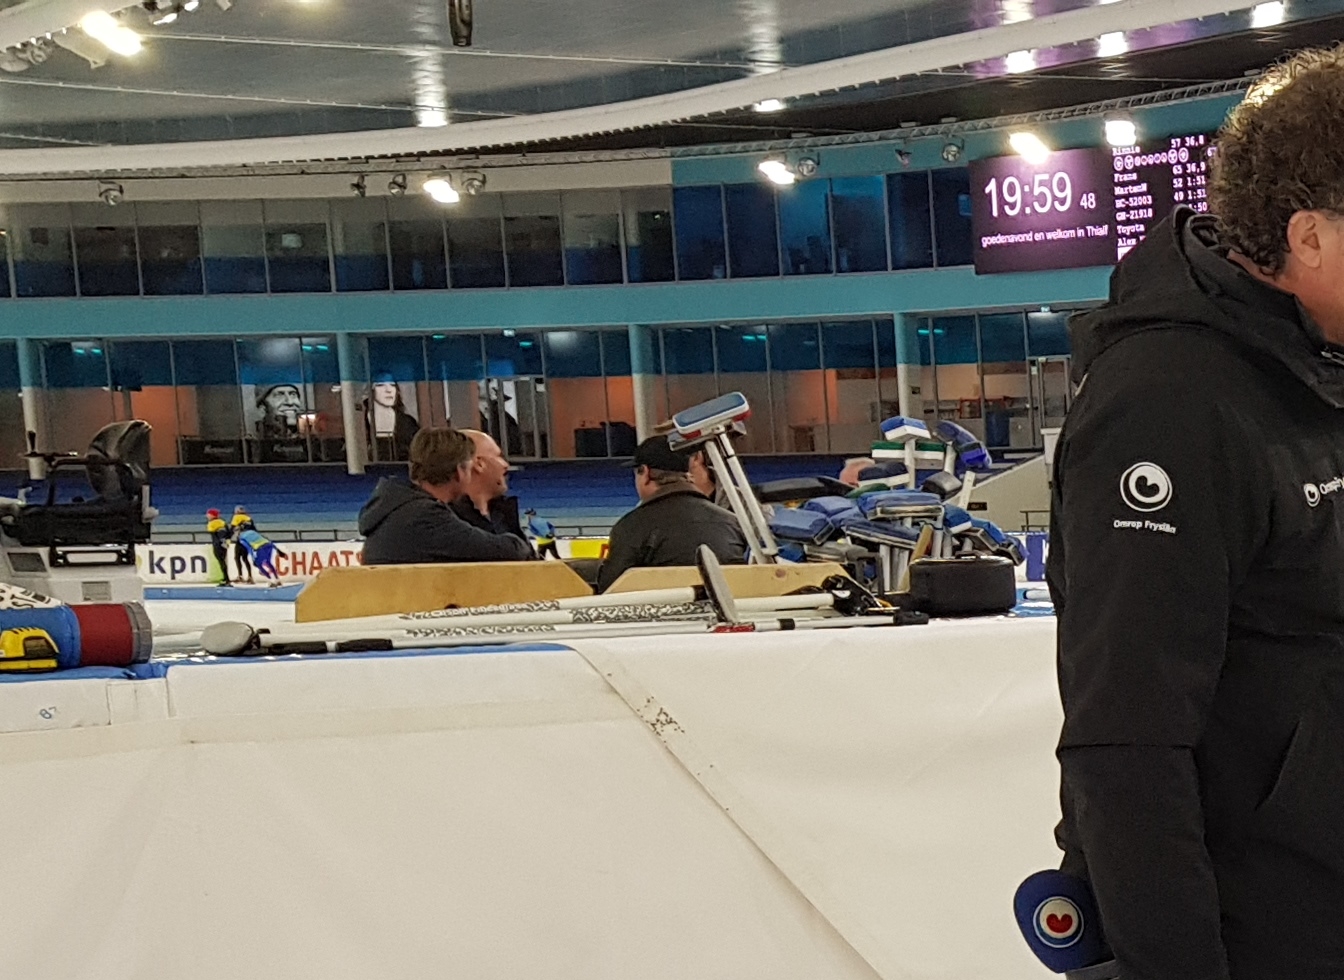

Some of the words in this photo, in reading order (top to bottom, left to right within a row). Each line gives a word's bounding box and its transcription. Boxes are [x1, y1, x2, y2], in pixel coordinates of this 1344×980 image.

[985, 171, 1072, 217] 19:59
[1080, 192, 1096, 209] 48
[981, 231, 1033, 248] goedenavond
[1046, 229, 1075, 240] welkom
[149, 550, 207, 580] kpn
